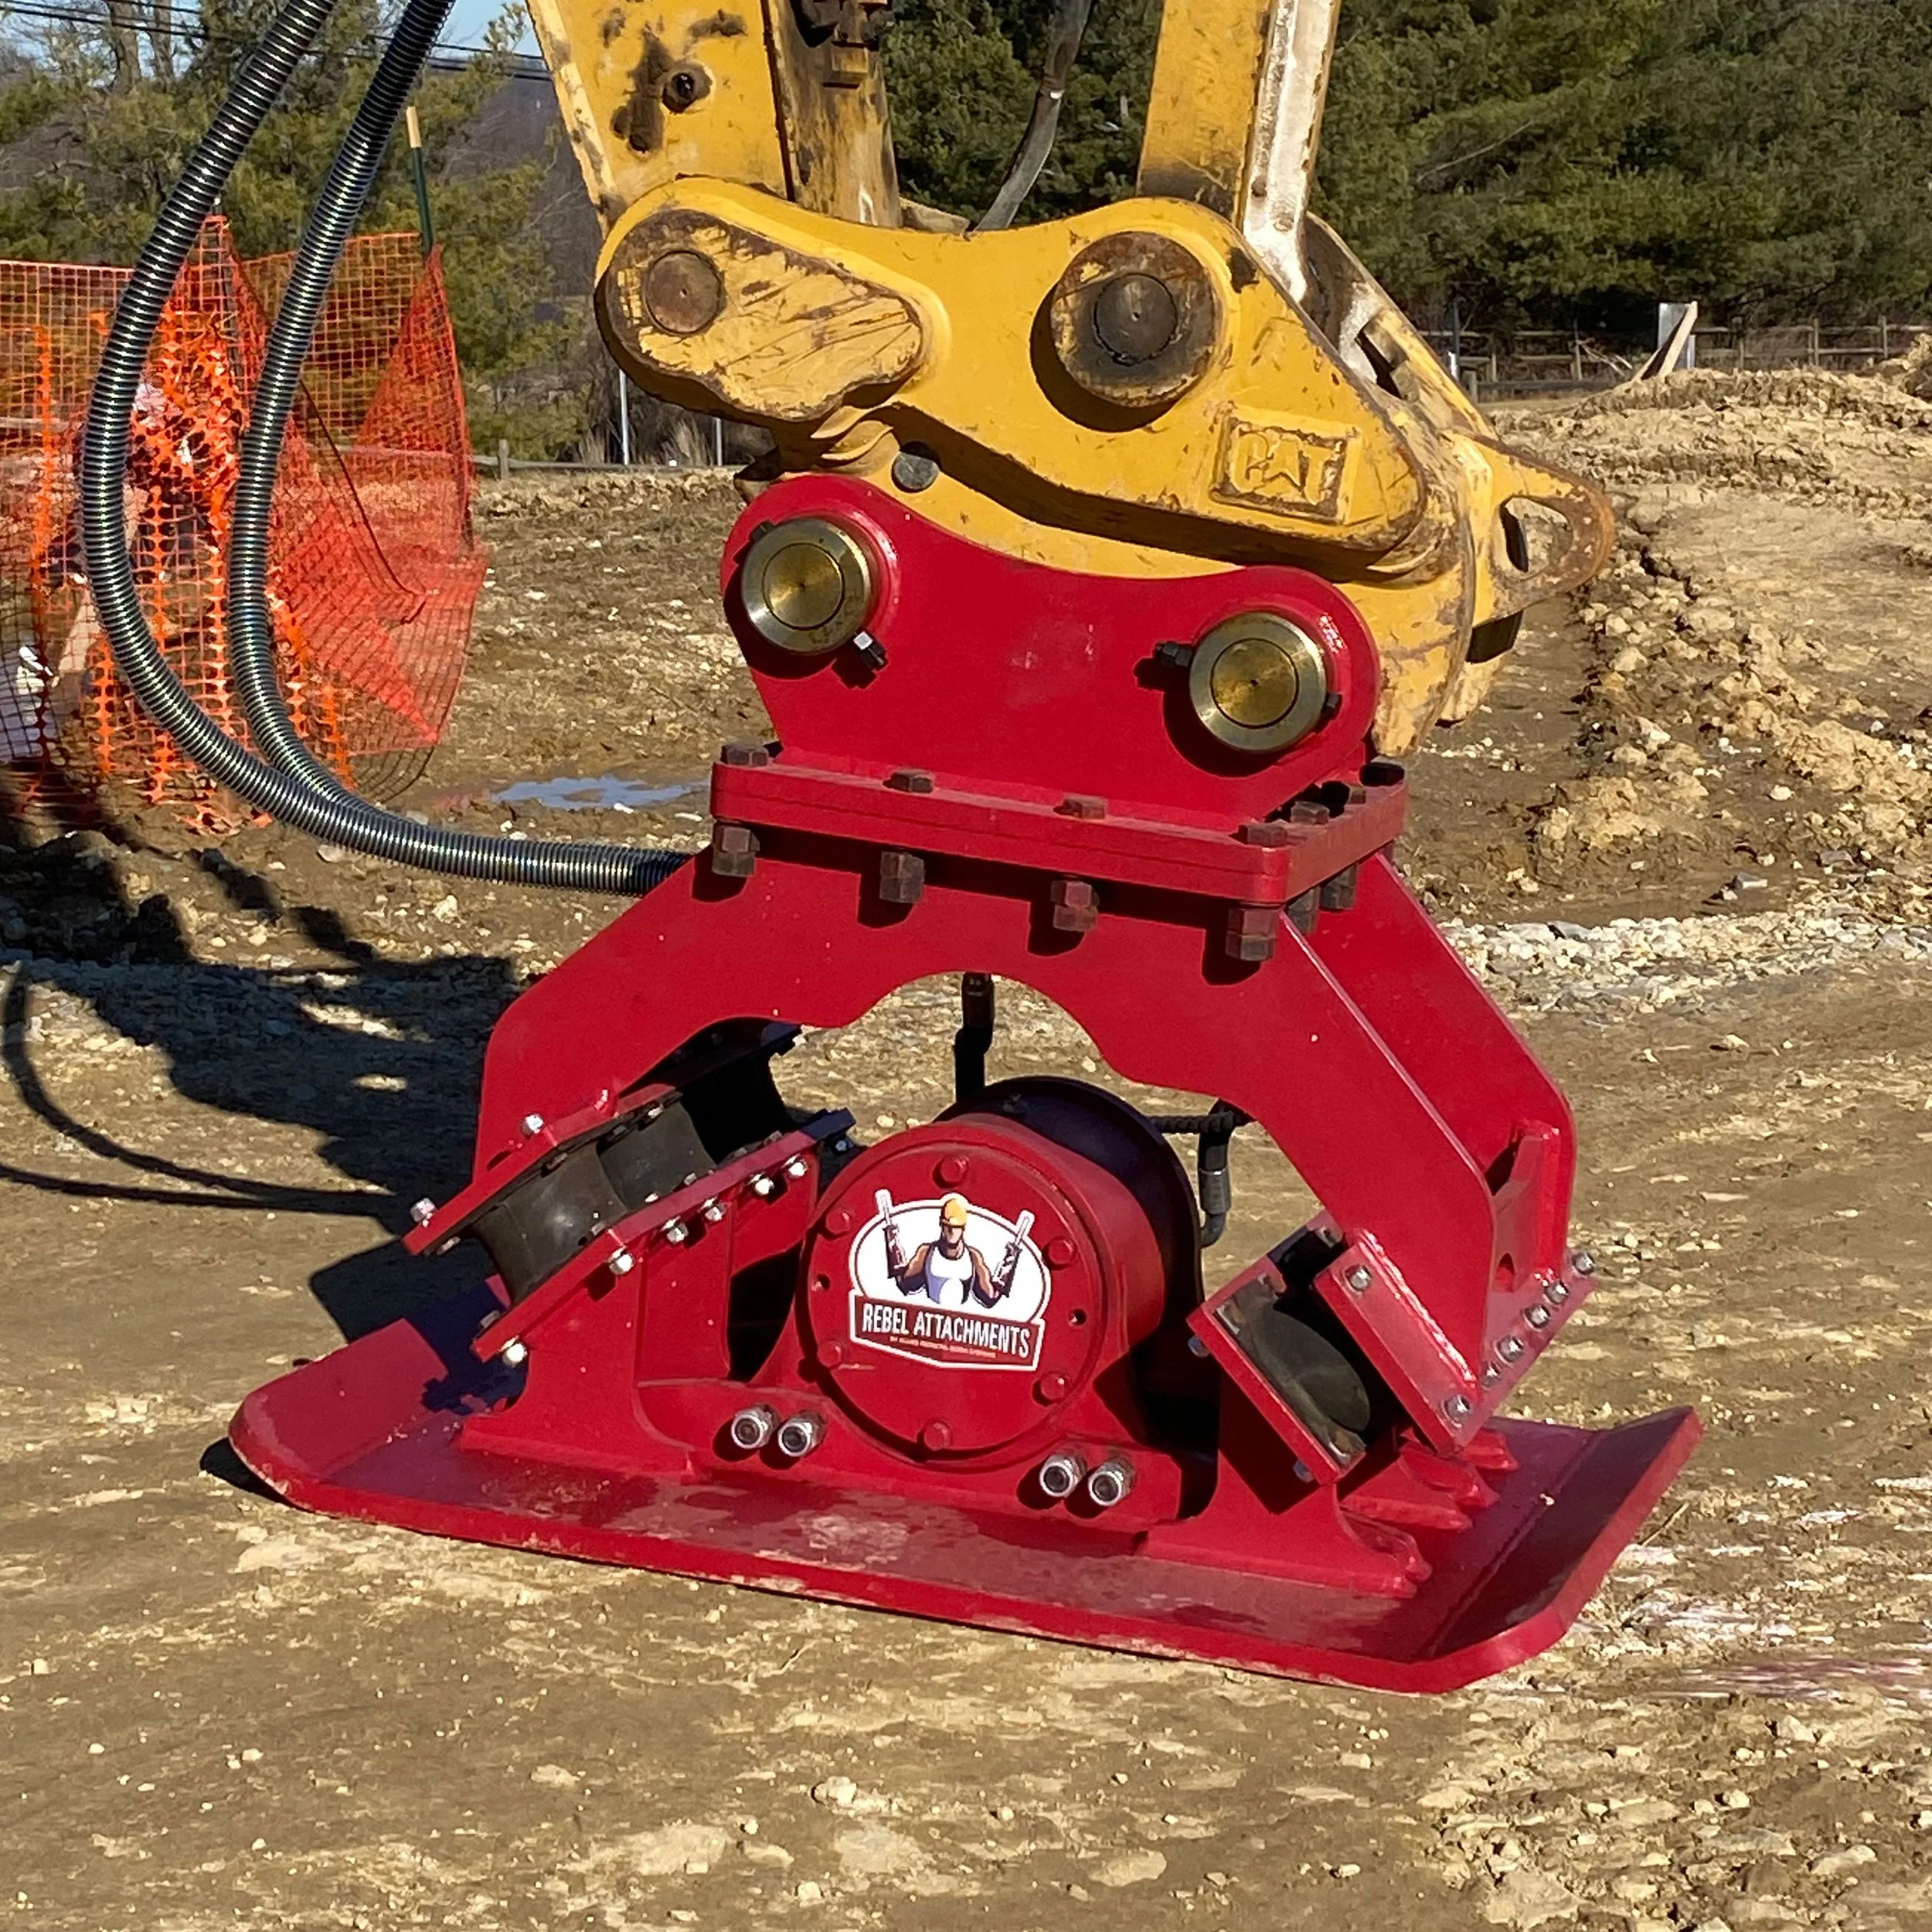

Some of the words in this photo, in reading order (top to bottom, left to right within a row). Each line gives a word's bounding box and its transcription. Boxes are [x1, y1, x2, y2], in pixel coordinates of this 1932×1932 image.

[1231, 431, 1341, 505] CAT
[862, 1303, 910, 1335] REBEL
[913, 1311, 1030, 1358] ATTACHMENTS
